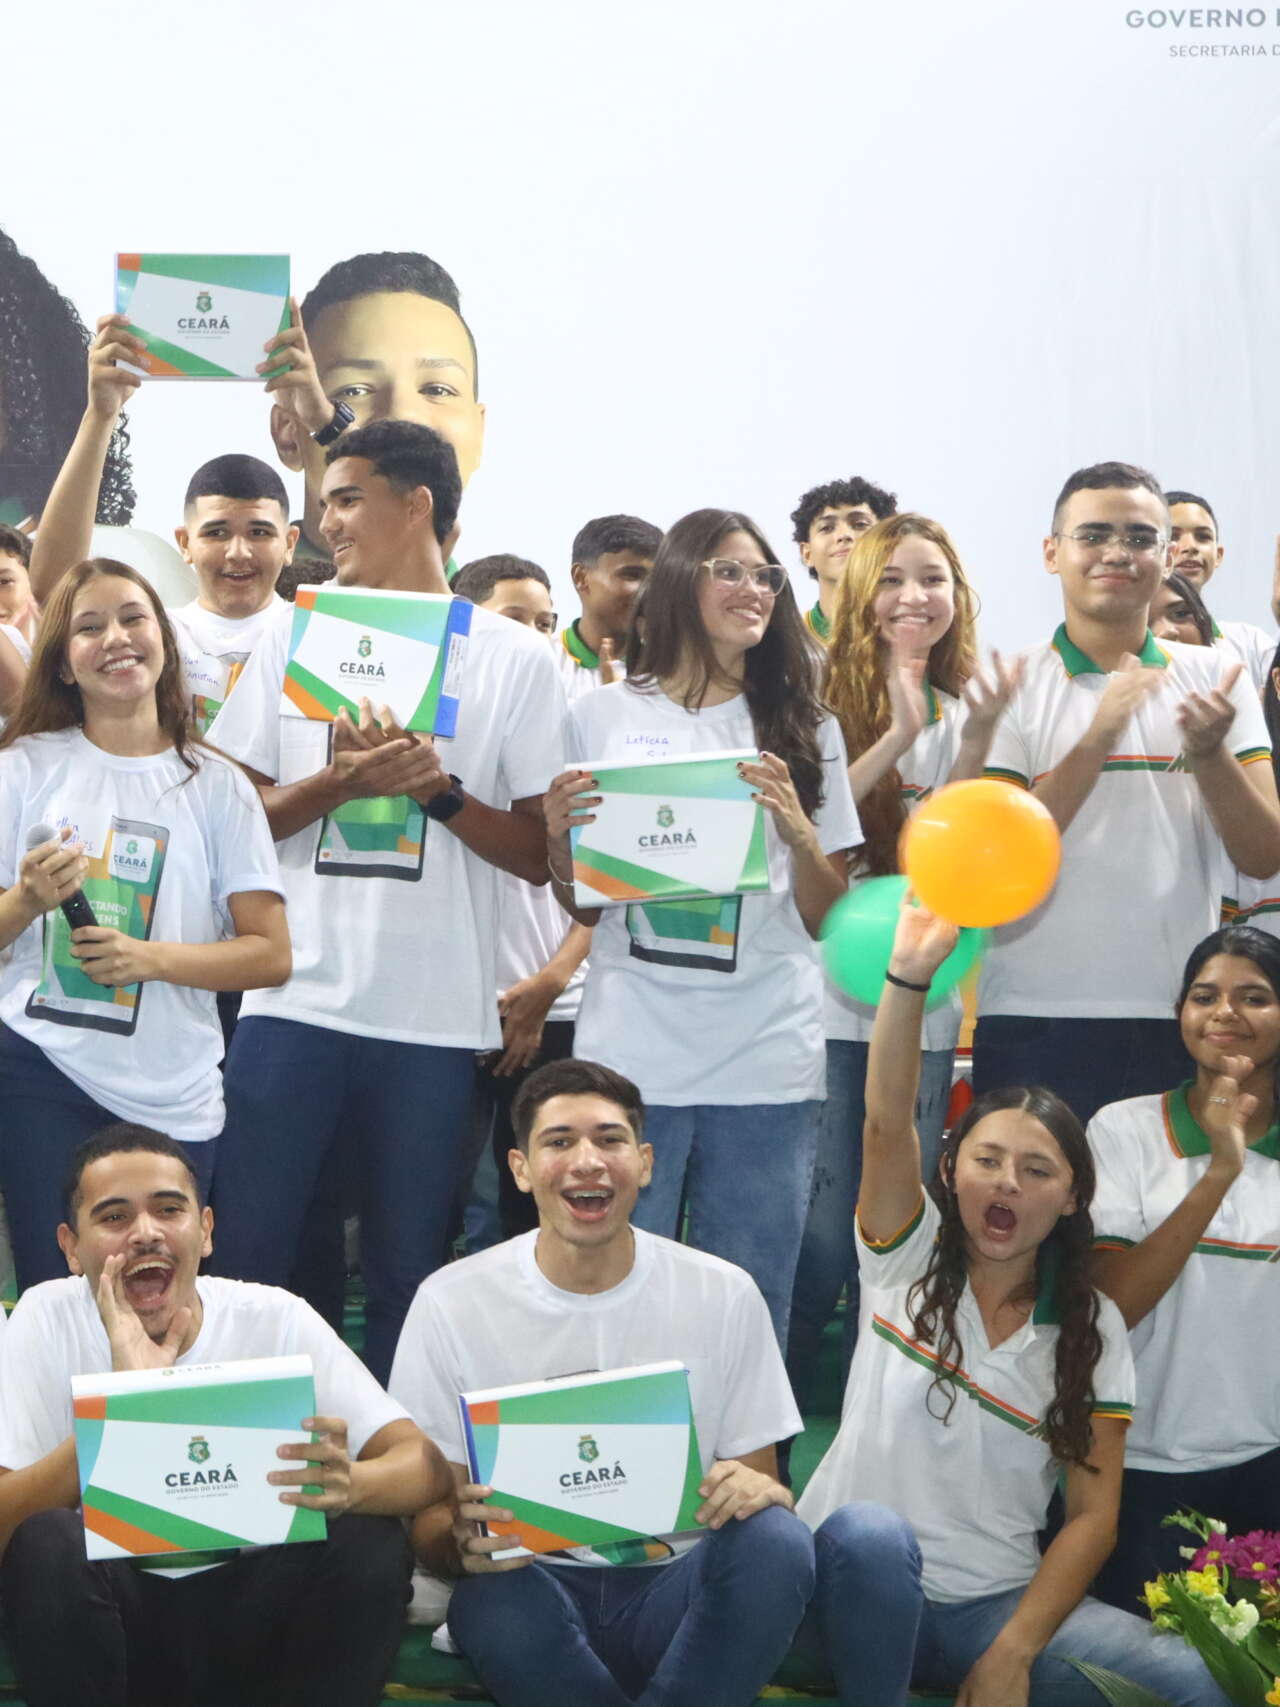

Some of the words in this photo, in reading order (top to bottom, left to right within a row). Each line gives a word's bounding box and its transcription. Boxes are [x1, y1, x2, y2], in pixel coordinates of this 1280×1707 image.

[1126, 8, 1267, 29] GOVERNO
[1169, 45, 1268, 57] SECRETARIA
[177, 315, 230, 329] CEARÁ
[339, 662, 385, 677] CEARÁ
[638, 828, 697, 847] CEARÁ
[114, 854, 148, 869] CEARÁ
[165, 1464, 238, 1487] CEARÁ
[560, 1461, 626, 1487] CEARÁ
